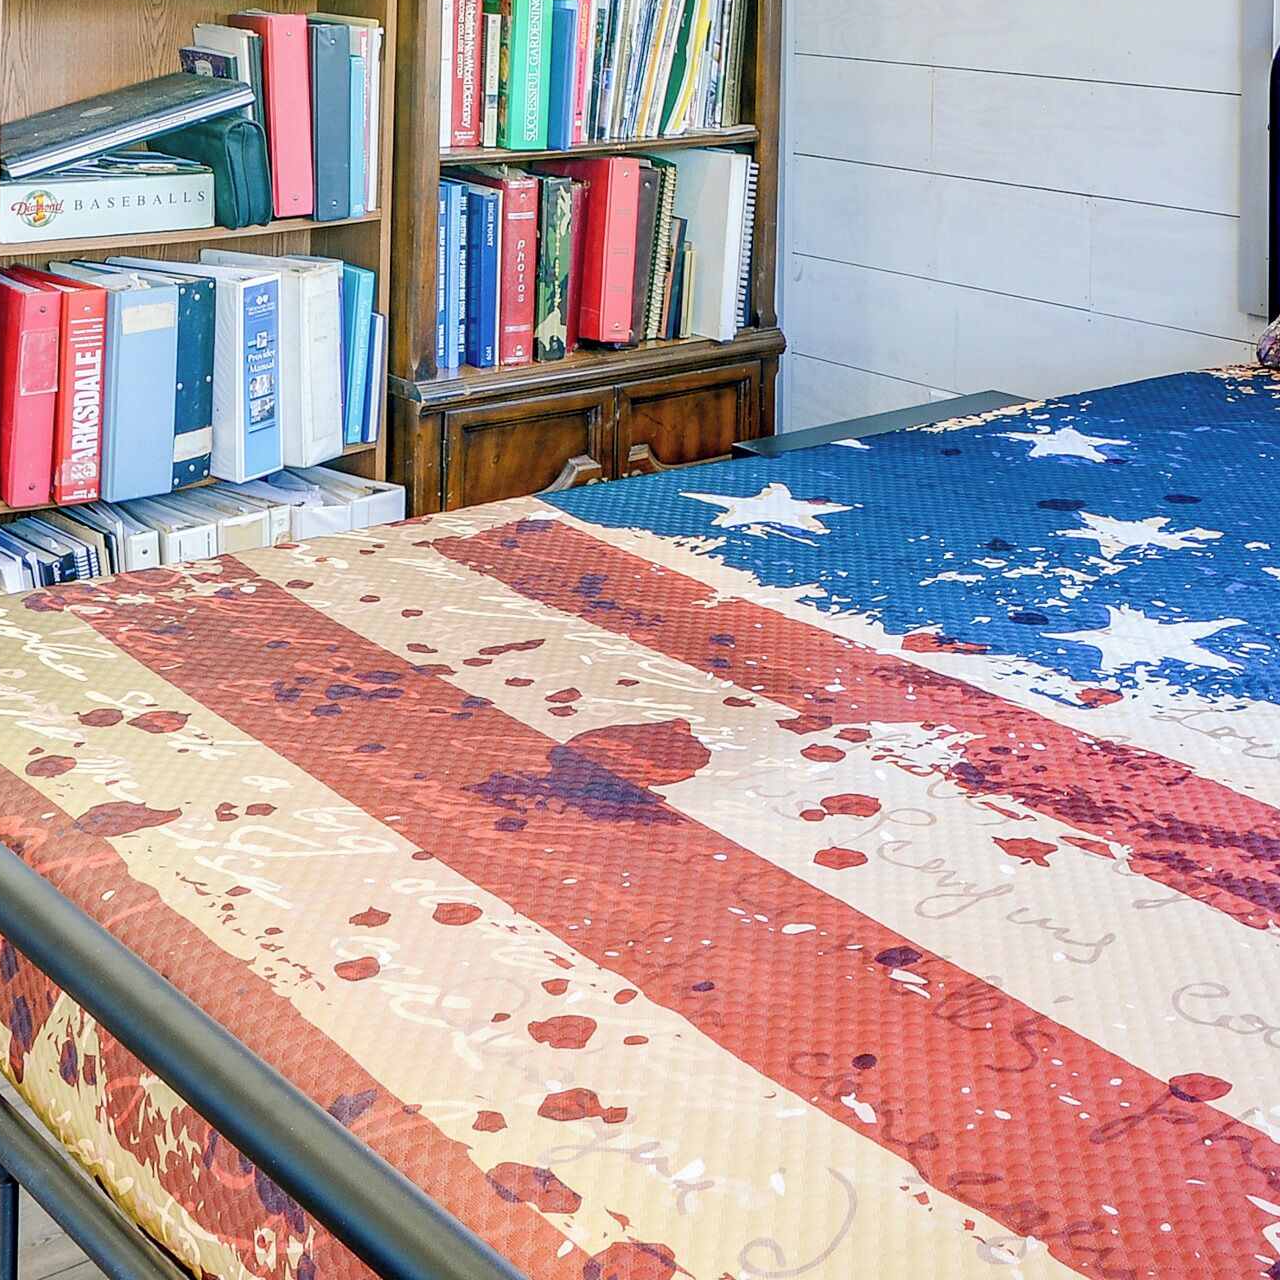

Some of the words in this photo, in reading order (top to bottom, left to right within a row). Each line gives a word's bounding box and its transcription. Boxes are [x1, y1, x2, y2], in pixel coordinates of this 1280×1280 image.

[579, 3, 588, 48] carpentry
[465, 41, 475, 57] New
[464, 58, 474, 85] World
[461, 85, 473, 128] Dictionary
[526, 72, 540, 141] SUCCESSFUL
[11, 199, 64, 216] Diamond
[74, 191, 205, 211] BASEBALLS
[516, 239, 526, 303] photos
[247, 349, 276, 363] Provider
[248, 359, 274, 374] Manual
